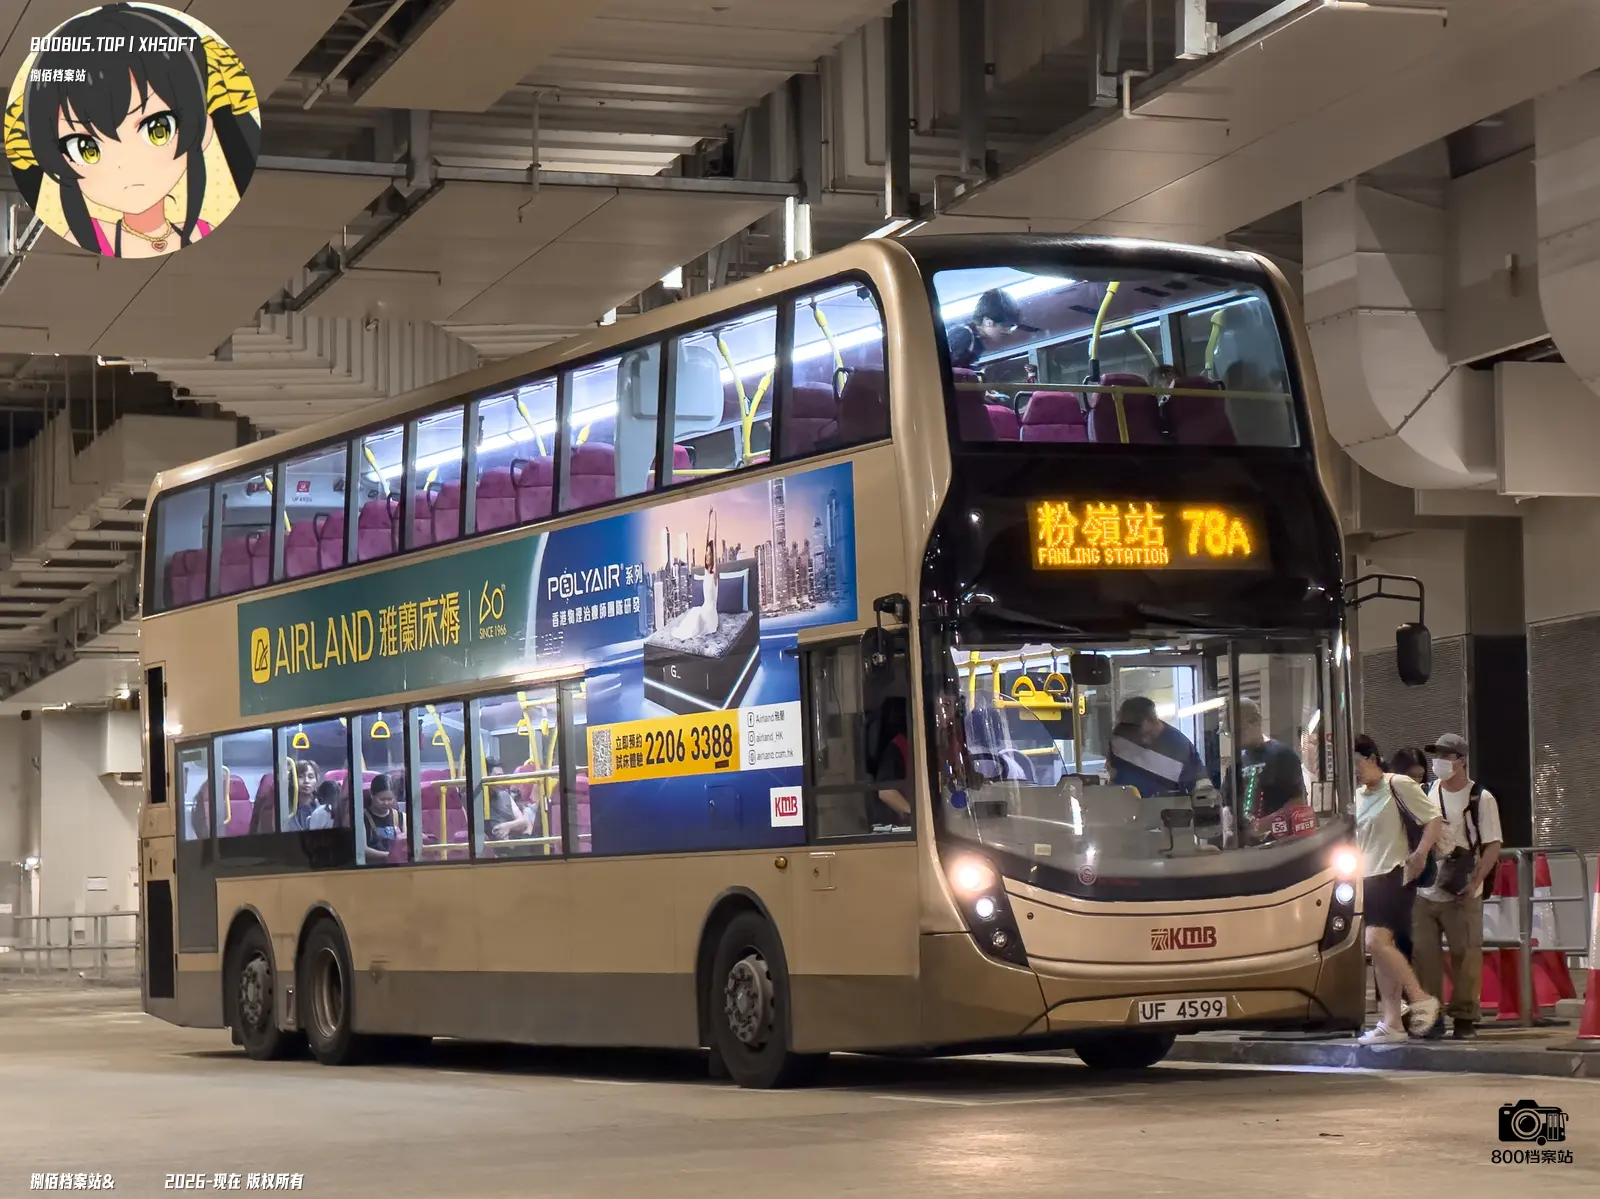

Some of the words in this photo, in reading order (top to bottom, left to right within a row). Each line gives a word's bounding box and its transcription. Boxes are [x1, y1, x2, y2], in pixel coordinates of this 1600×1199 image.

[1037, 501, 1166, 548] 粉嶺站
[1180, 508, 1252, 556] 78A
[1037, 547, 1101, 565] FANLING
[1104, 547, 1169, 565] STATION
[625, 563, 643, 586] 系列
[274, 609, 374, 677] AIRLAND
[379, 591, 460, 657] 雅蘭床褥
[479, 626, 494, 640] SINCE
[494, 624, 507, 637] 1966
[645, 728, 686, 765] 2206
[690, 723, 733, 761] 3388
[774, 795, 798, 817] KMB
[1169, 926, 1218, 950] KMB
[1142, 1002, 1166, 1020] UF
[1176, 1000, 1223, 1019] 4599
